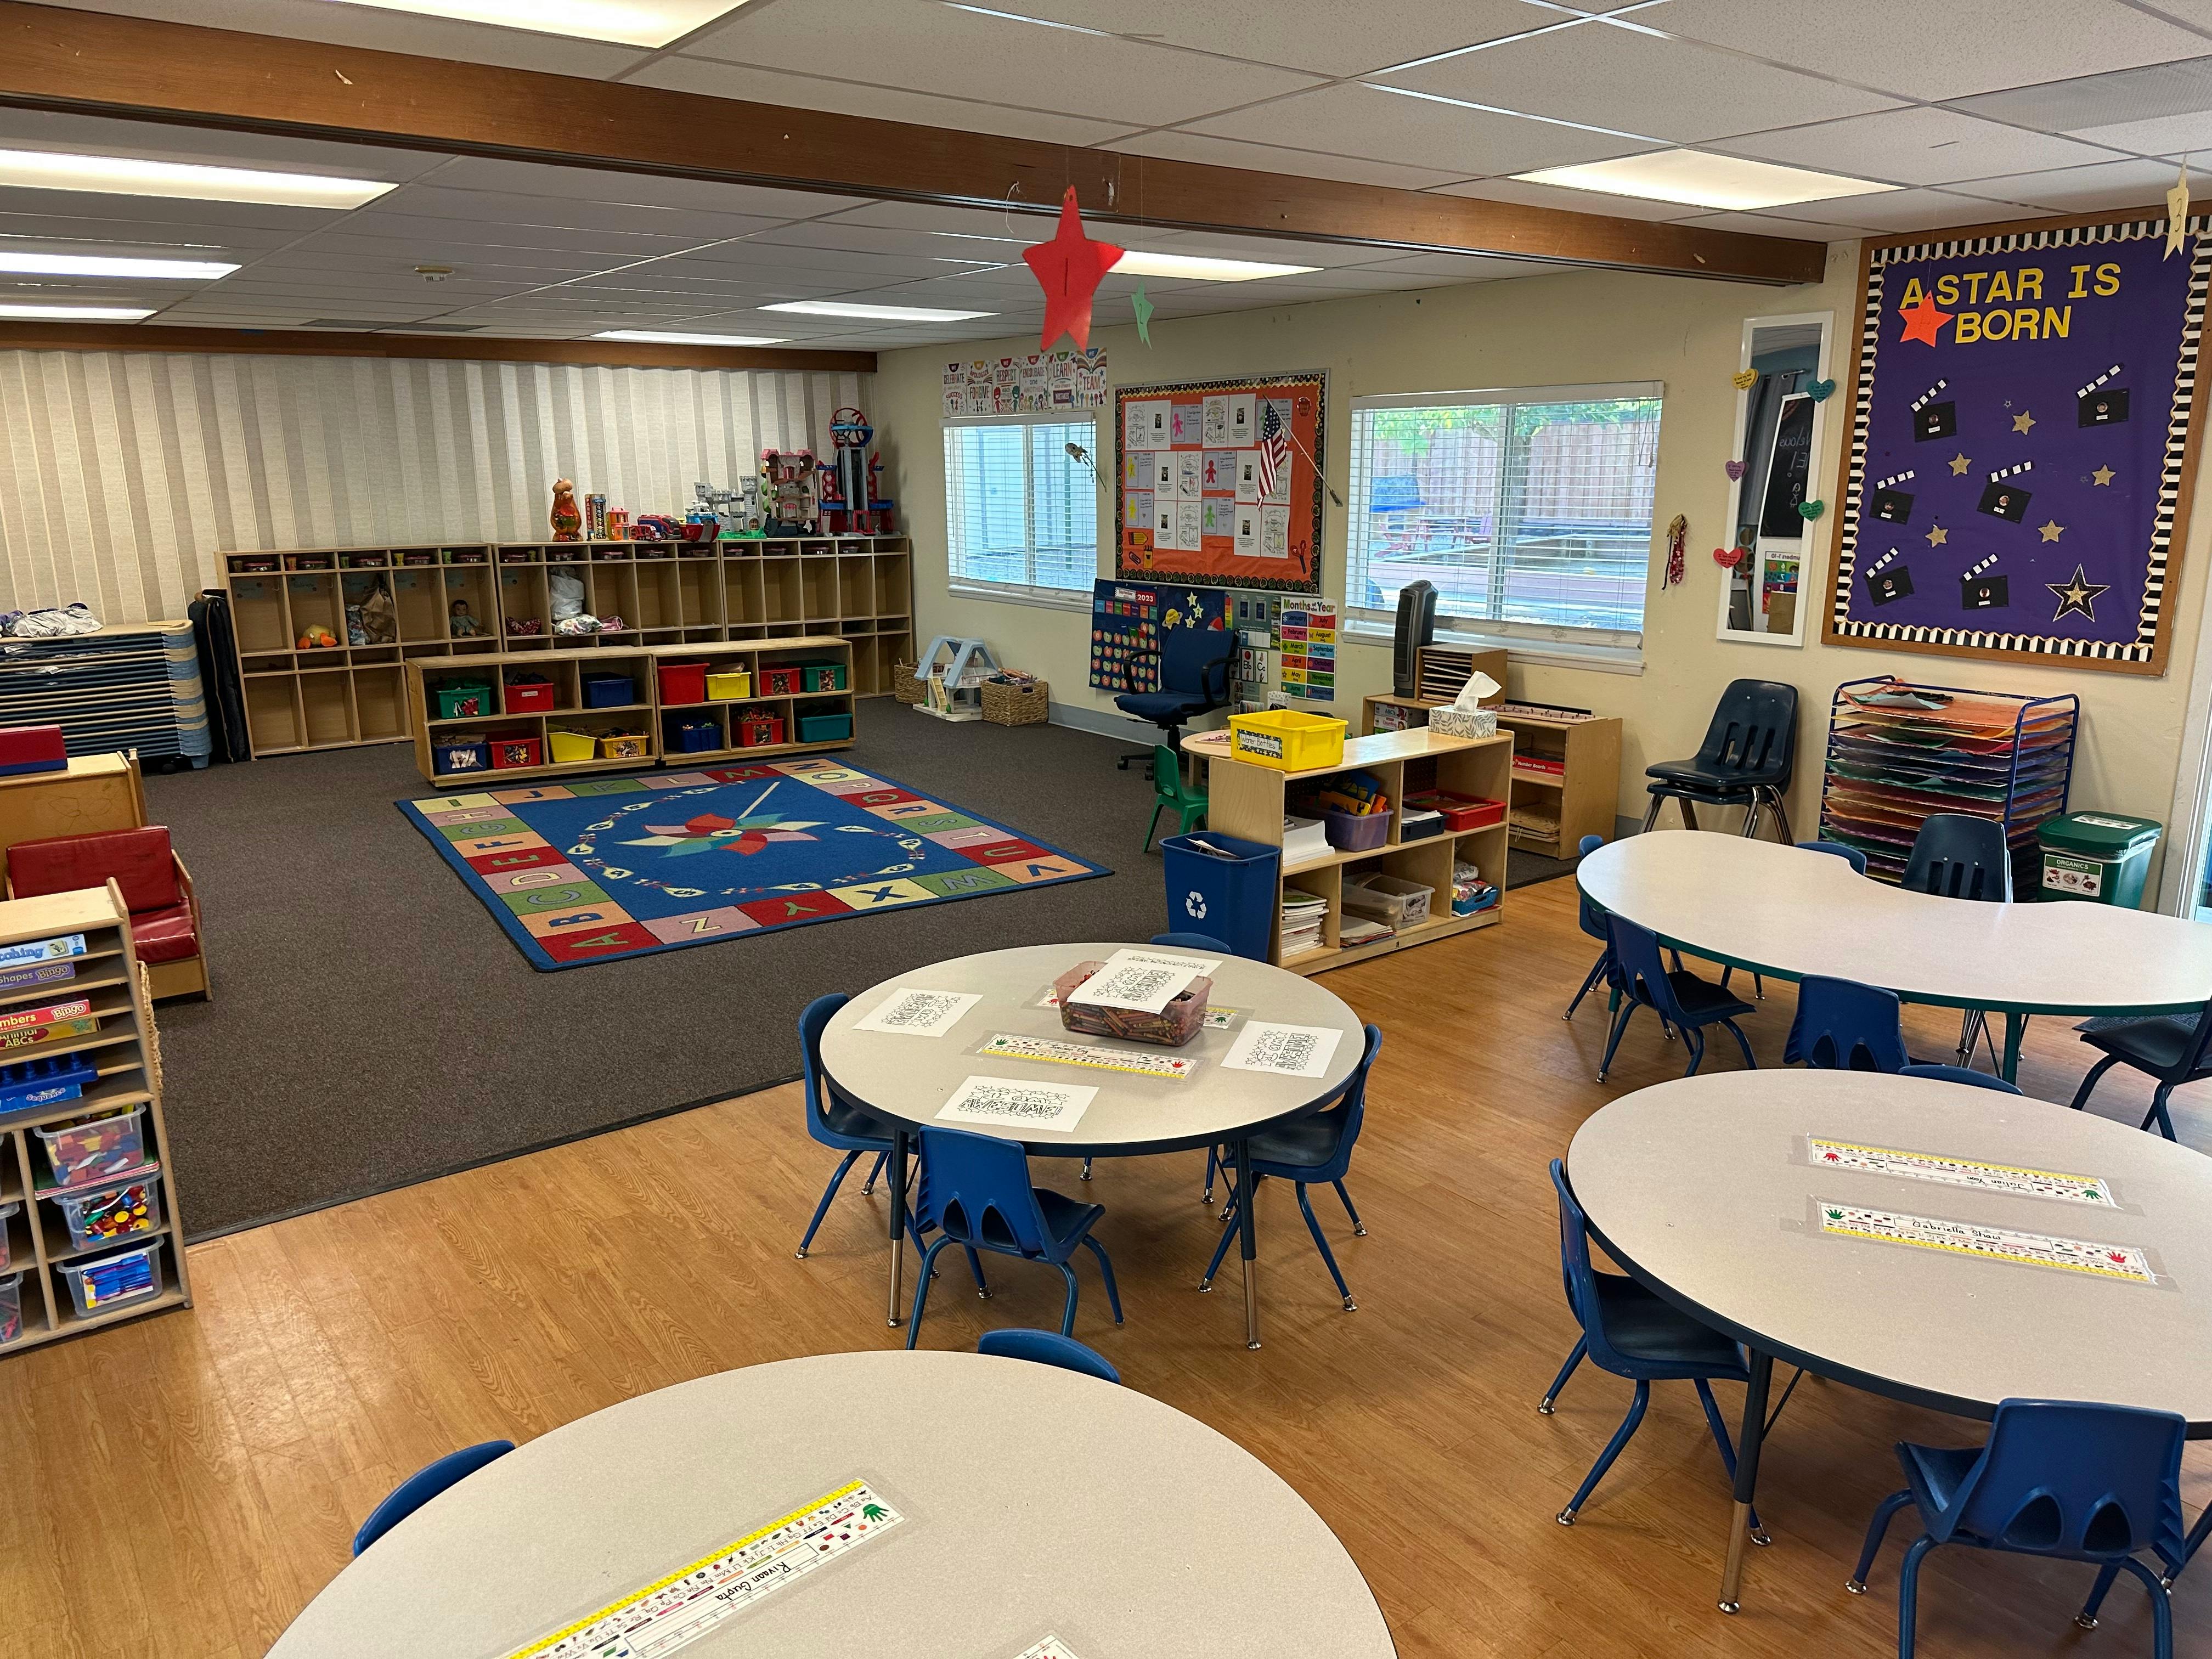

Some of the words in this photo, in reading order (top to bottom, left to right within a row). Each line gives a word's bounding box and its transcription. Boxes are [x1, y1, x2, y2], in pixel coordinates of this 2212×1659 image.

[1899, 278, 1923, 309] A
[1936, 268, 2045, 305] STAR
[2068, 263, 2121, 298] IS
[1955, 306, 2072, 344] BORN
[996, 368, 1017, 382] RESPECT
[1053, 362, 1072, 378] LEARN
[1083, 375, 1101, 391] TEAM
[970, 386, 989, 400] FORGIVE
[1137, 594, 1154, 602] 2023
[1283, 599, 1311, 611] Months
[1317, 602, 1335, 613] Year
[1244, 661, 1251, 669] Bb
[1257, 662, 1266, 672] Cc
[1257, 737, 1276, 749] Bottles
[788, 763, 826, 771] N
[724, 769, 766, 779] M
[812, 772, 848, 780] O
[591, 782, 627, 792] K
[524, 791, 544, 799] J
[861, 793, 899, 804] Q
[887, 805, 927, 815] R
[445, 811, 492, 821] H
[918, 818, 957, 827] S
[461, 824, 507, 834] G
[950, 832, 991, 840] T
[474, 840, 523, 849] F
[983, 846, 1026, 857] U
[491, 854, 539, 866] E
[1026, 864, 1066, 877] V
[510, 872, 562, 886] D
[940, 875, 994, 891] W
[527, 890, 581, 904] C
[855, 886, 909, 902] X
[783, 901, 819, 917] Y
[549, 912, 605, 927] B
[680, 916, 723, 933] Z
[569, 932, 629, 947] A
[38, 965, 69, 980] Bingo
[53, 1005, 85, 1019] Bingo
[5, 1035, 34, 1049] ABCs
[26, 1087, 66, 1102] Sequence
[1012, 1096, 1047, 1104] am
[958, 1097, 1063, 1116] AWESOME!
[1991, 1180, 2024, 1189] Julian
[1912, 1221, 1965, 1235] Gabriella
[1972, 1229, 2001, 1240] Shaw
[861, 1494, 873, 1503] Aa
[837, 1506, 849, 1516] Cc
[850, 1501, 861, 1510] Bb
[825, 1514, 837, 1523] Dd
[802, 1526, 813, 1534] Ff
[812, 1521, 824, 1529] Ee
[787, 1529, 802, 1542] Gg
[776, 1538, 789, 1548] Hh
[754, 1549, 766, 1559] Jj
[743, 1555, 755, 1565] Kk
[732, 1562, 742, 1571] Ll
[751, 1561, 791, 1583] Rivaan
[714, 1568, 731, 1580] Mm
[673, 1592, 686, 1601] Oo
[715, 1581, 752, 1602] Gupta
[644, 1604, 659, 1616] Qq
[629, 1614, 642, 1623] Rr
[616, 1622, 628, 1630] Ss
[605, 1629, 615, 1637] Tt
